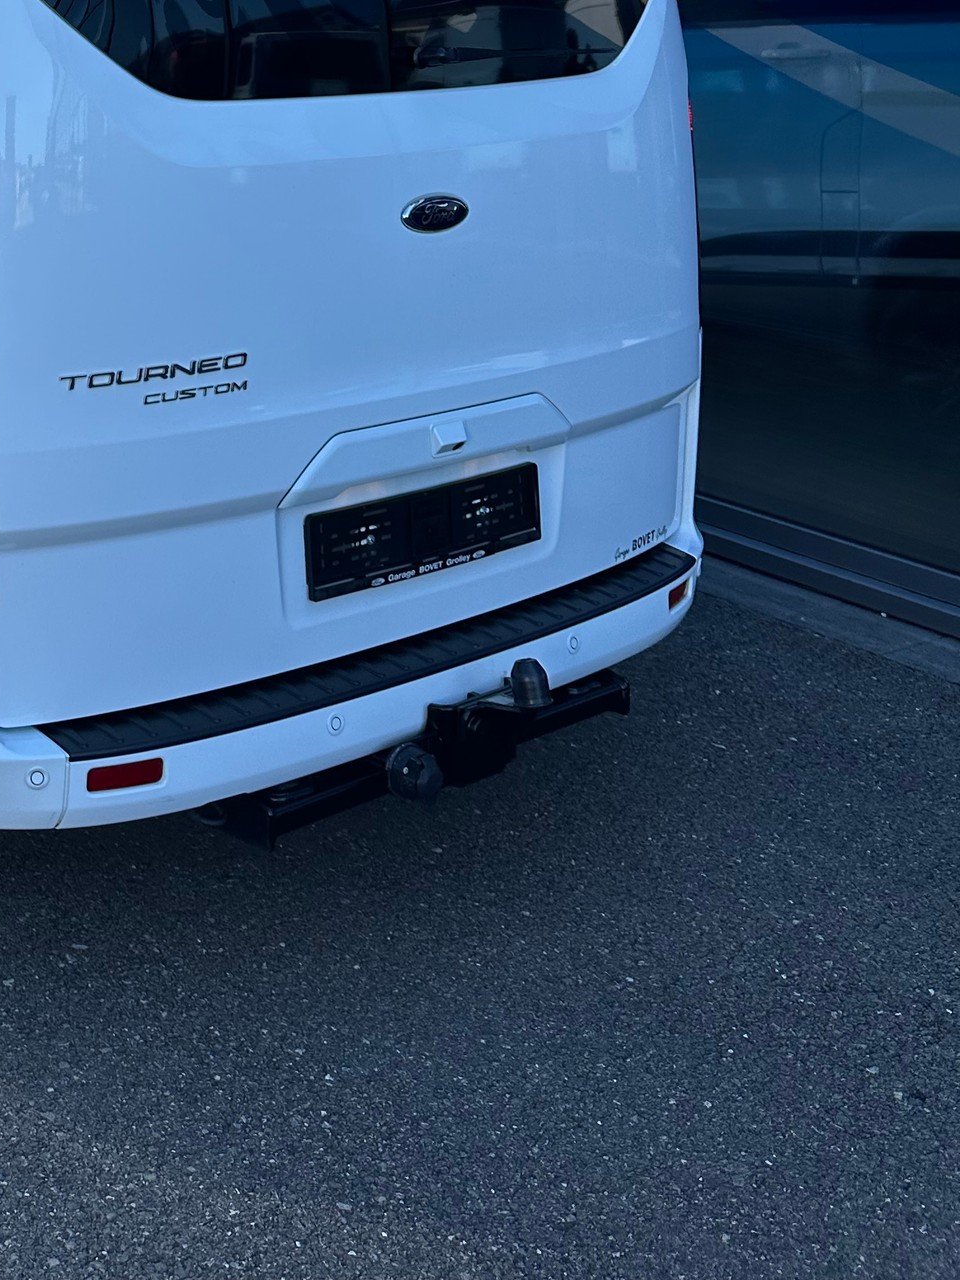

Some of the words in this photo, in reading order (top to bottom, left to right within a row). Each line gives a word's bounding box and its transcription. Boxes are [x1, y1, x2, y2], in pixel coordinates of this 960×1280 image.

[59, 352, 248, 391] TOURNEO
[143, 380, 248, 405] CUSTOM
[632, 529, 656, 551] BOVET
[388, 569, 416, 582] Garage
[419, 560, 444, 574] BOVET
[446, 554, 471, 566] Grolley
